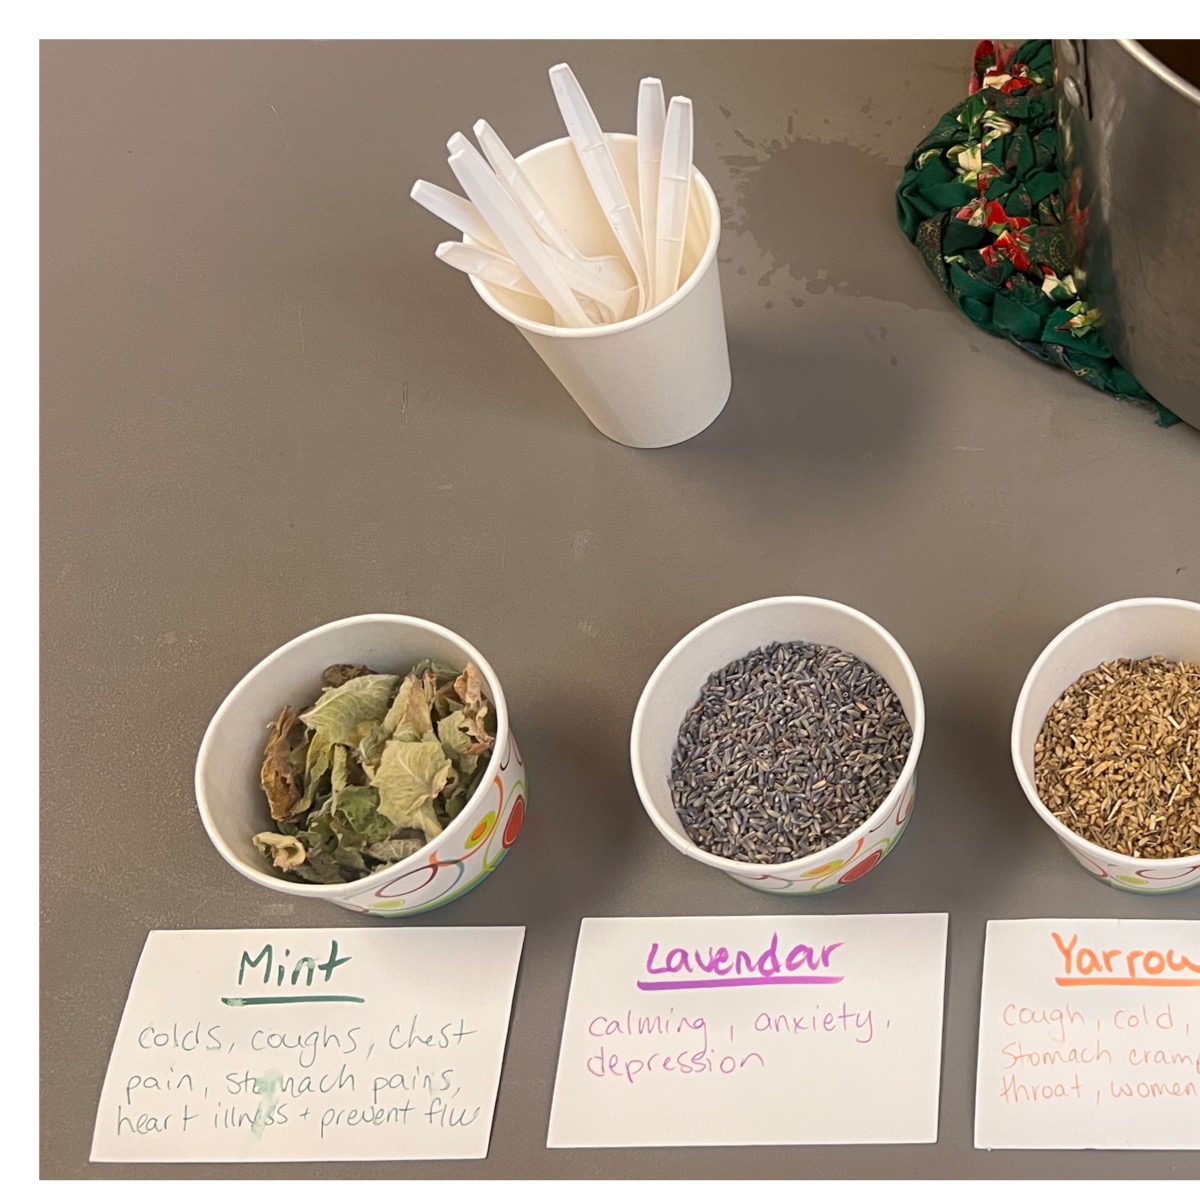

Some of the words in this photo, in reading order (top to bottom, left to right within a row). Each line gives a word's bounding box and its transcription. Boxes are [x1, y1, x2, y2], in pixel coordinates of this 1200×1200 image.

[237, 939, 352, 987] Mint
[646, 932, 845, 977] Lavendar
[586, 1047, 765, 1082] depression
[116, 1104, 200, 1138] heart
[213, 1100, 288, 1130] illnss
[320, 1101, 415, 1138] prevent
